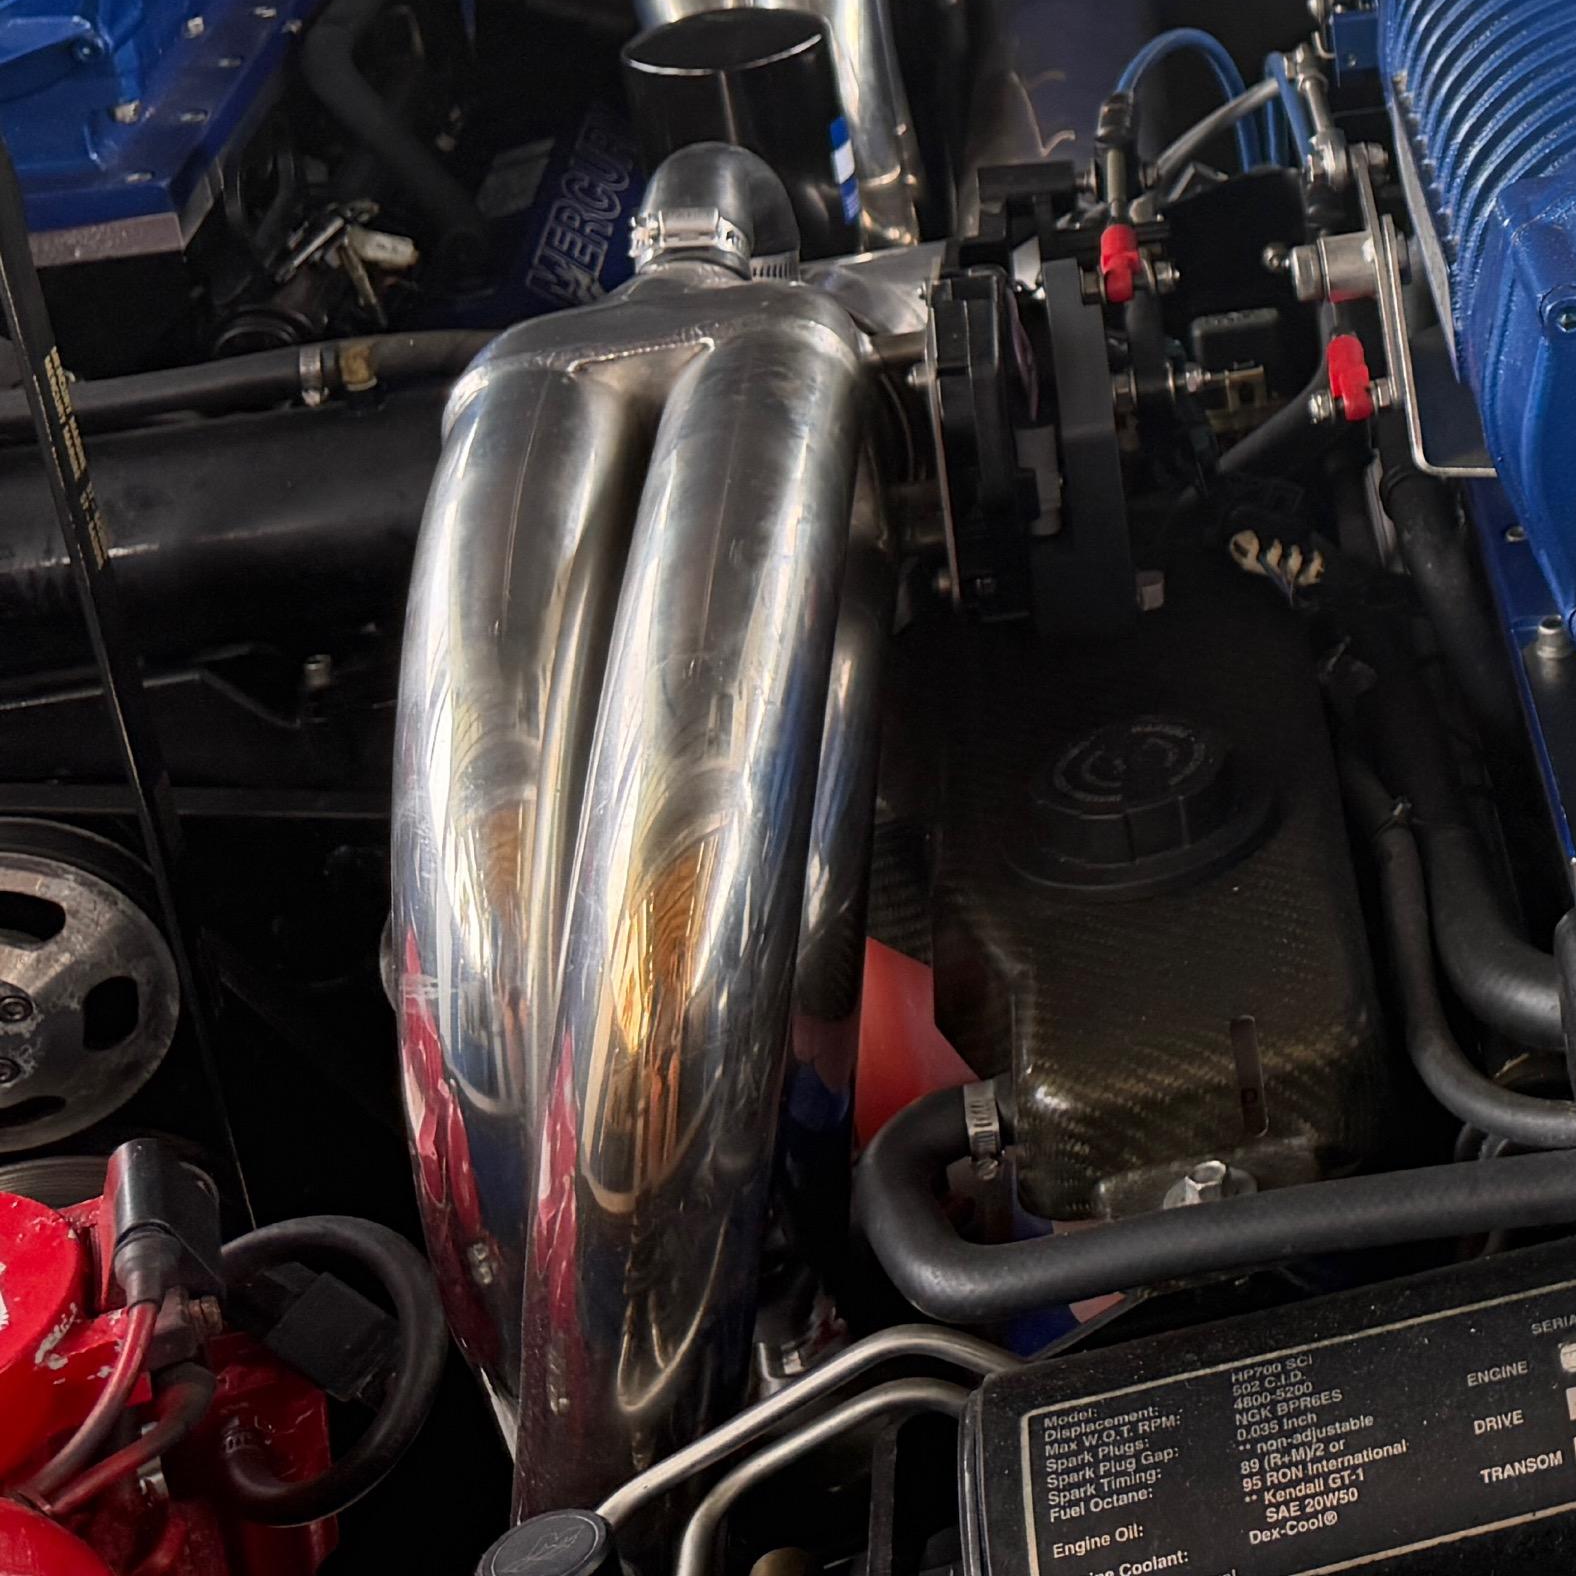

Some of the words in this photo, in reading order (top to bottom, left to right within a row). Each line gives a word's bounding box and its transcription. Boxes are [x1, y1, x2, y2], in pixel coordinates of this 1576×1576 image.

[1231, 1362, 1281, 1383] HP700
[1232, 1380, 1260, 1396] 502
[1265, 1370, 1306, 1388] C.I.D.
[1467, 1360, 1528, 1387] ENGINE
[1233, 1381, 1313, 1410] 4800-5200
[1235, 1405, 1272, 1426] NGK
[1277, 1389, 1343, 1415] BPR6ES
[1044, 1408, 1097, 1427] Model:
[1045, 1406, 1159, 1441] Displacement:
[1236, 1422, 1279, 1441] 0.035
[1257, 1414, 1374, 1454] non-adjustable
[1473, 1410, 1524, 1435] DRIVE
[1045, 1440, 1077, 1456] Max
[1083, 1426, 1134, 1446] W.O.T.
[1139, 1415, 1181, 1433] RPM:
[1046, 1452, 1093, 1472] Spark
[1098, 1438, 1149, 1460] Plugs:
[1047, 1467, 1095, 1489] Spark
[1100, 1454, 1136, 1475] Plug
[1141, 1447, 1180, 1464] Gap:
[1240, 1457, 1260, 1475] 89
[1264, 1442, 1325, 1471] (R+M)/2
[1329, 1439, 1346, 1452] or
[1243, 1475, 1262, 1491] 95
[1266, 1464, 1304, 1486] RON
[1307, 1439, 1408, 1473] International
[1480, 1450, 1563, 1484] TRANSOM
[1048, 1483, 1096, 1505] Spark
[1100, 1468, 1161, 1491] Timing:
[1264, 1476, 1324, 1505] Kendall
[1328, 1467, 1365, 1489] GT-1
[1050, 1502, 1085, 1522] Fuel
[1089, 1487, 1153, 1512] Octane:
[1266, 1501, 1301, 1522] SAE
[1305, 1487, 1358, 1514] 20W50
[1053, 1532, 1111, 1558] Engine
[1115, 1523, 1144, 1542] Oil:
[1119, 1550, 1189, 1576] Coolant:
